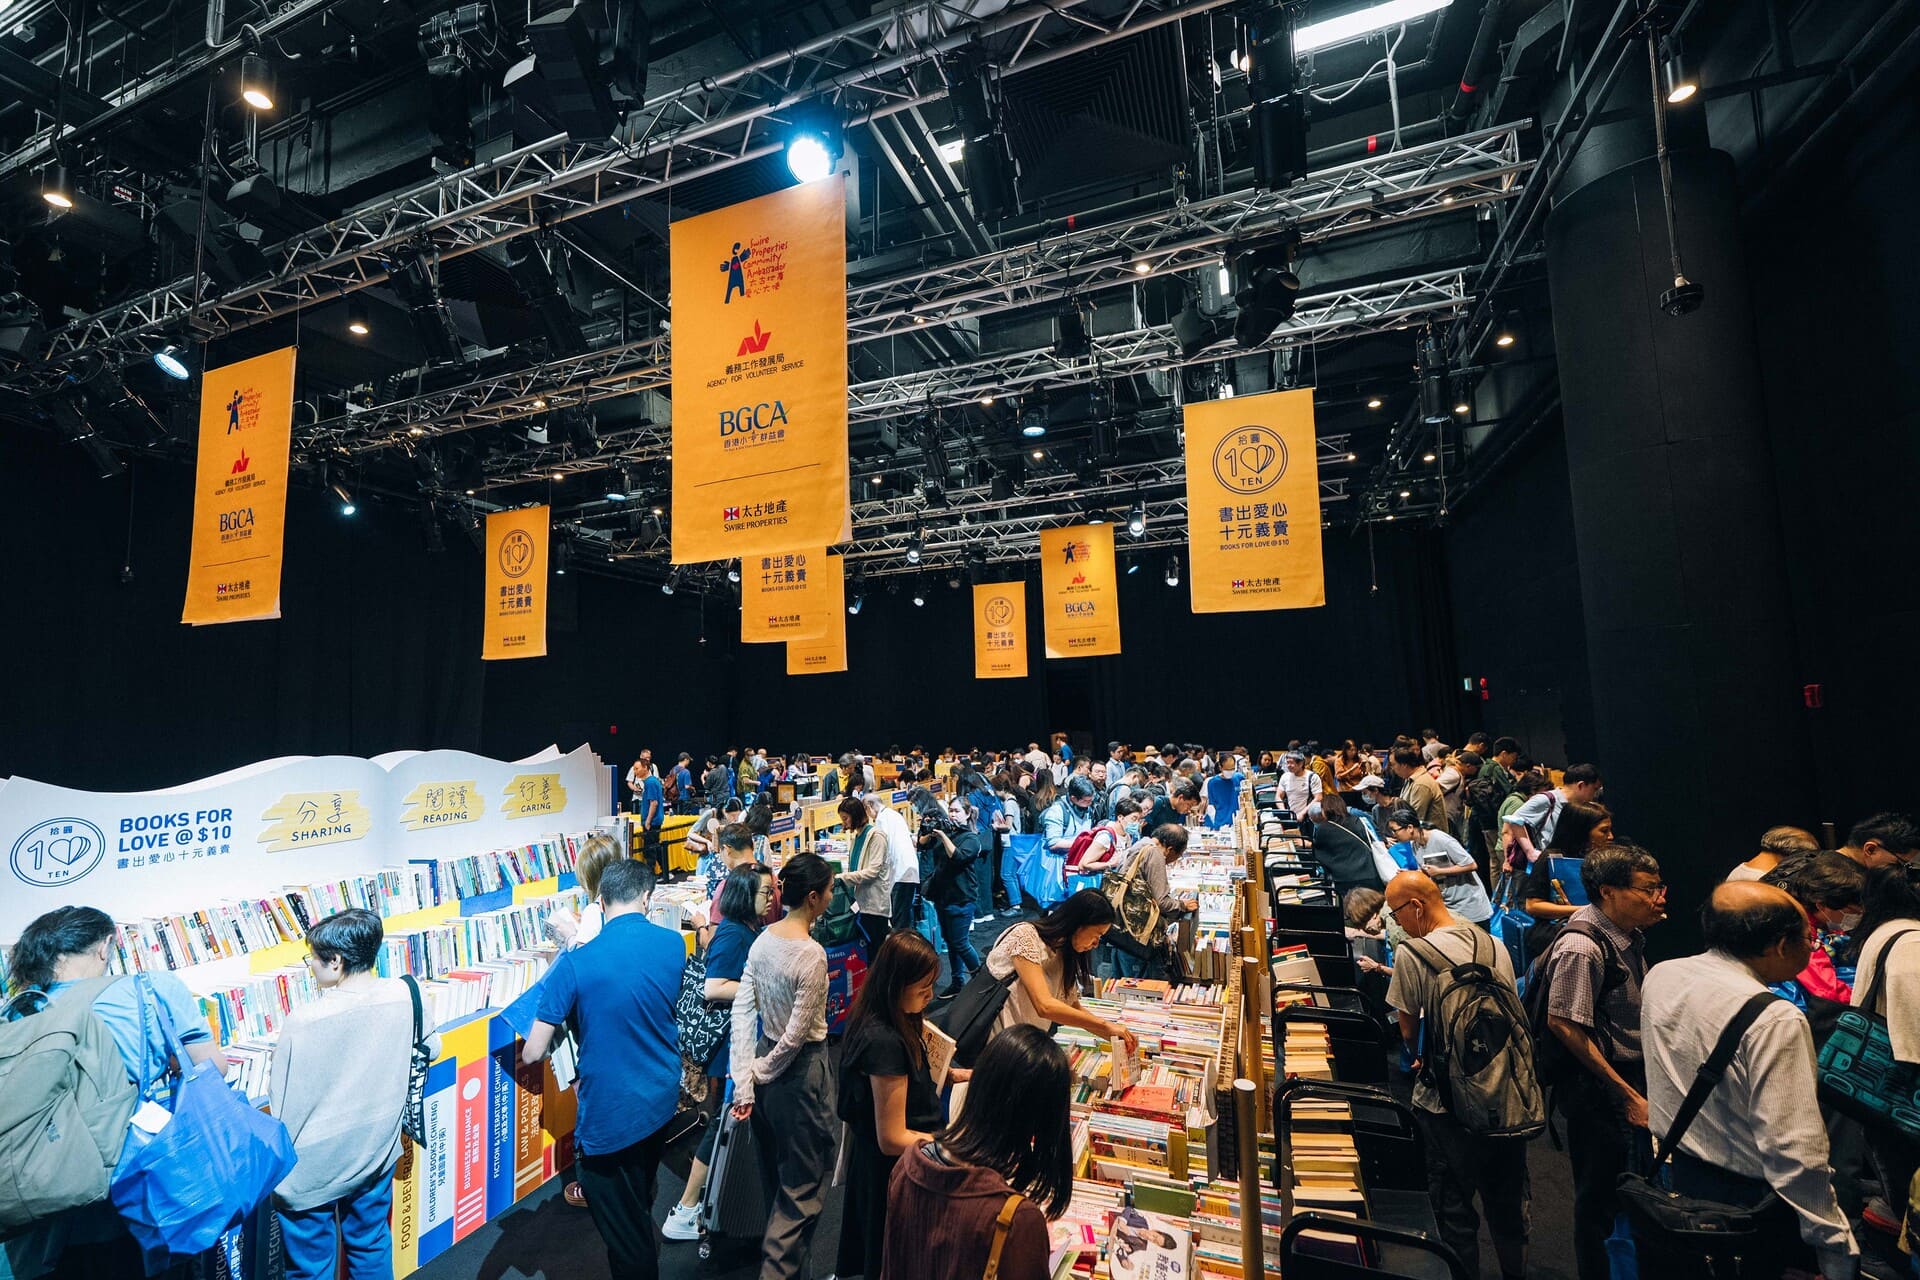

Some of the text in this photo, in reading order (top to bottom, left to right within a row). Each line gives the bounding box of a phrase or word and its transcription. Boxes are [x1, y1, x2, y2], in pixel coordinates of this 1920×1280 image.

[751, 241, 788, 258] Properties
[706, 359, 804, 389] AGENCY FOR VOLUNTEER SERVICE
[725, 353, 785, 375] 義務工作發展局
[719, 400, 788, 437] BGCA
[1240, 477, 1263, 486] TEN
[742, 499, 787, 519] 太古地產
[1219, 502, 1287, 522] 書出愛心
[219, 507, 255, 533] BGCA
[724, 516, 788, 533] SWIRE PROPERTIES
[1219, 520, 1288, 540] 十元義賣
[1220, 543, 1240, 551] BOOKS
[1241, 541, 1253, 549] FOR
[762, 554, 806, 570] 書出愛心
[762, 569, 806, 584] 十元義賣
[1065, 601, 1095, 613] BGCA
[296, 794, 348, 824] 分享
[423, 811, 468, 824] READING
[521, 802, 551, 814] CARING
[120, 809, 233, 833] BOOKS FOR
[118, 825, 231, 852] LOVE @ $10
[291, 824, 351, 842] SHARING
[116, 844, 231, 870] 書出愛心十元義賣
[48, 870, 69, 879] TEN
[495, 1055, 503, 1093] (CHI/ENG)
[520, 1073, 530, 1160] LAW & POLITICS
[463, 1106, 473, 1190] BUSINESS & FINANCE
[428, 1100, 440, 1223] CHILDREN'S BOOKS (CHI/ENG)
[493, 1147, 501, 1179] FICTION
[401, 1135, 413, 1250] FOOD & BEVERAGES
